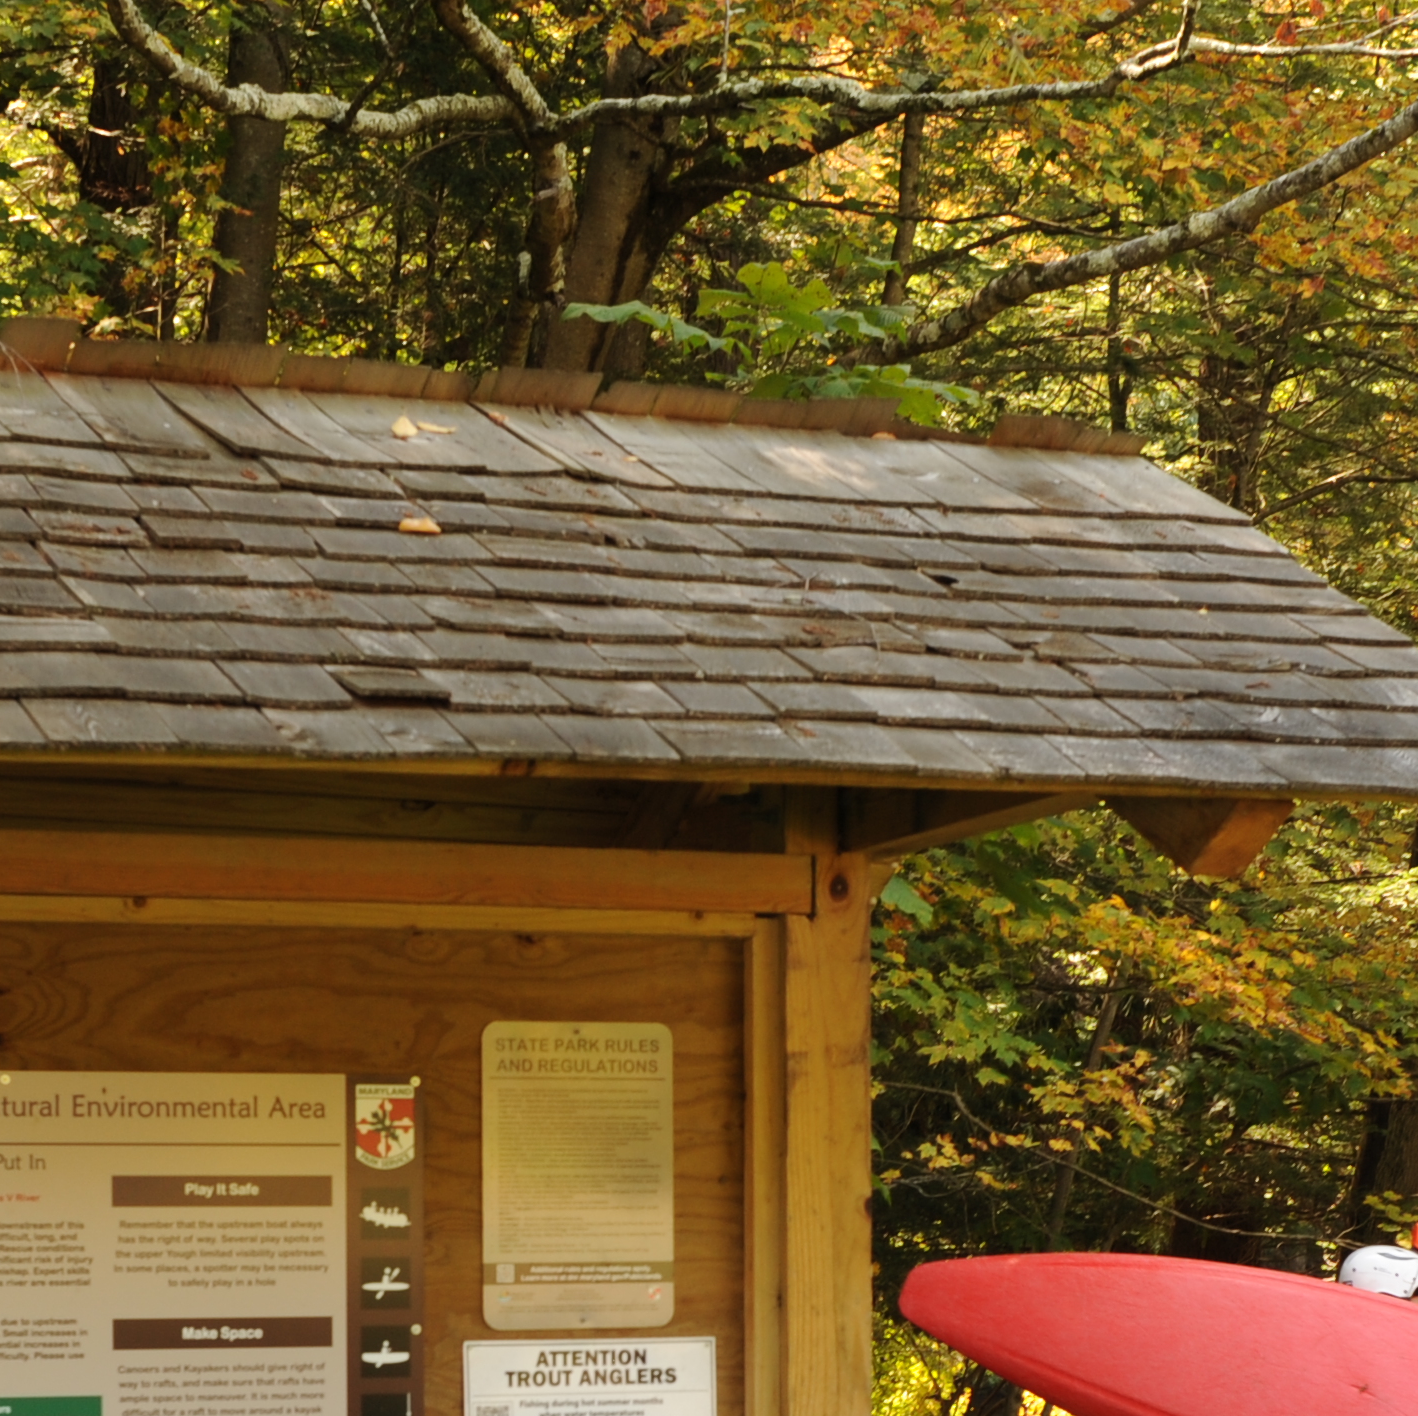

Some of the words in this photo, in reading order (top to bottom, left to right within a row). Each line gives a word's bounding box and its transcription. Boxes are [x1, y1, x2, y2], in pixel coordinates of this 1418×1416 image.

[495, 1038, 549, 1052] STATE
[554, 1038, 600, 1052] PARK
[605, 1039, 660, 1053] RULES
[497, 1059, 533, 1073] AND
[538, 1059, 658, 1073] REGULATIONS
[358, 1087, 412, 1095] MARYLAND
[72, 1094, 259, 1119] Environmental
[268, 1096, 326, 1119] Area
[29, 1153, 47, 1170] In
[6, 1194, 14, 1202] V
[15, 1193, 40, 1202] River
[184, 1182, 214, 1198] Play
[215, 1183, 227, 1196] It
[229, 1182, 259, 1196] Safe
[182, 1326, 218, 1340] Make
[220, 1326, 263, 1342] Space
[535, 1349, 647, 1367] ATTENTION
[504, 1370, 573, 1387] TROUT
[579, 1368, 677, 1385] ANGLERS
[519, 1400, 550, 1408] Fishing
[551, 1400, 580, 1408] during
[581, 1399, 595, 1407] hot
